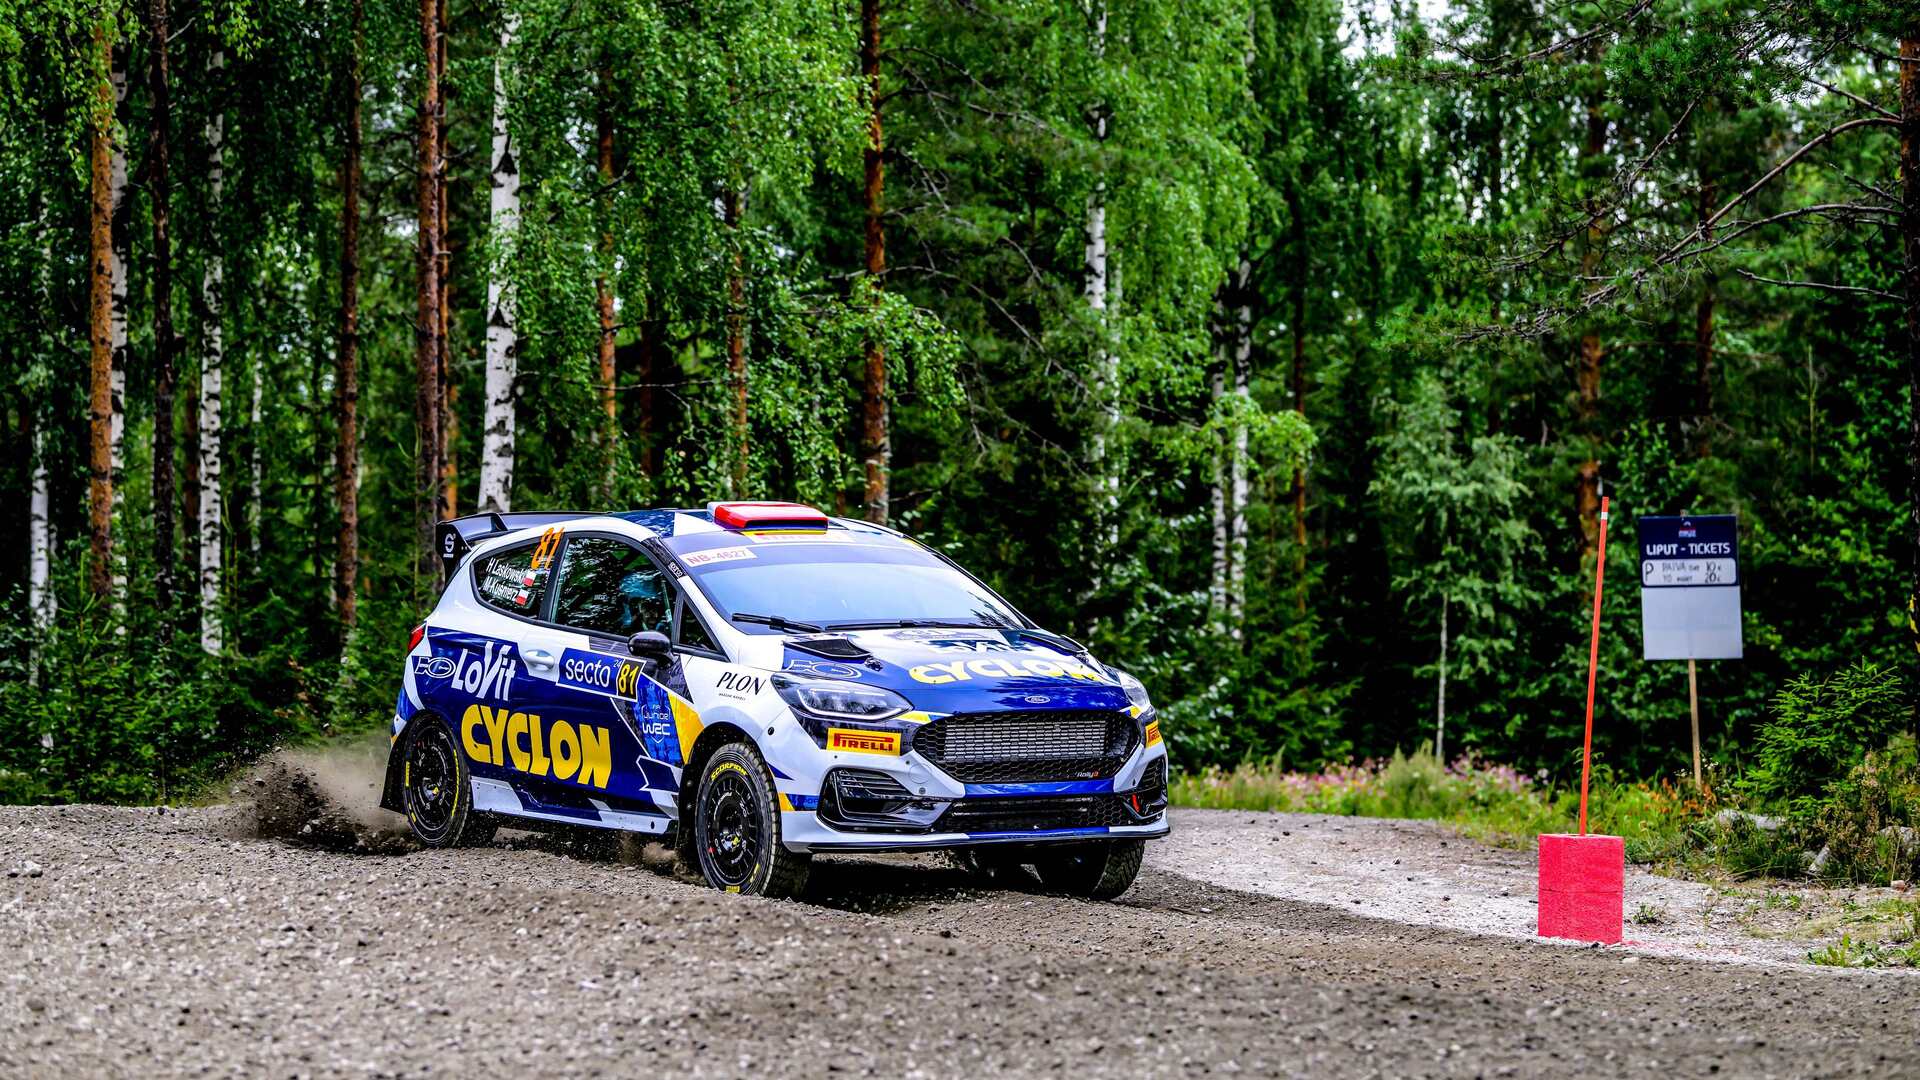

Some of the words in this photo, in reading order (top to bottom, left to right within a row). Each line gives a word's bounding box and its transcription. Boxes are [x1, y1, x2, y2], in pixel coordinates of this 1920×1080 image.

[531, 527, 564, 569] 81
[686, 550, 747, 564] NB-4627
[1646, 544, 1678, 555] LIPUT
[1688, 543, 1731, 554] TICKETS
[565, 659, 611, 688] secto
[618, 664, 639, 695] 81
[909, 658, 1102, 685] CYCLON
[716, 671, 767, 696] PLON
[643, 712, 669, 721] JUNIOR
[642, 722, 671, 735] WRC
[461, 704, 612, 789] CYCLON
[834, 733, 894, 752] PIRELLI
[711, 762, 748, 780] SCORPION
